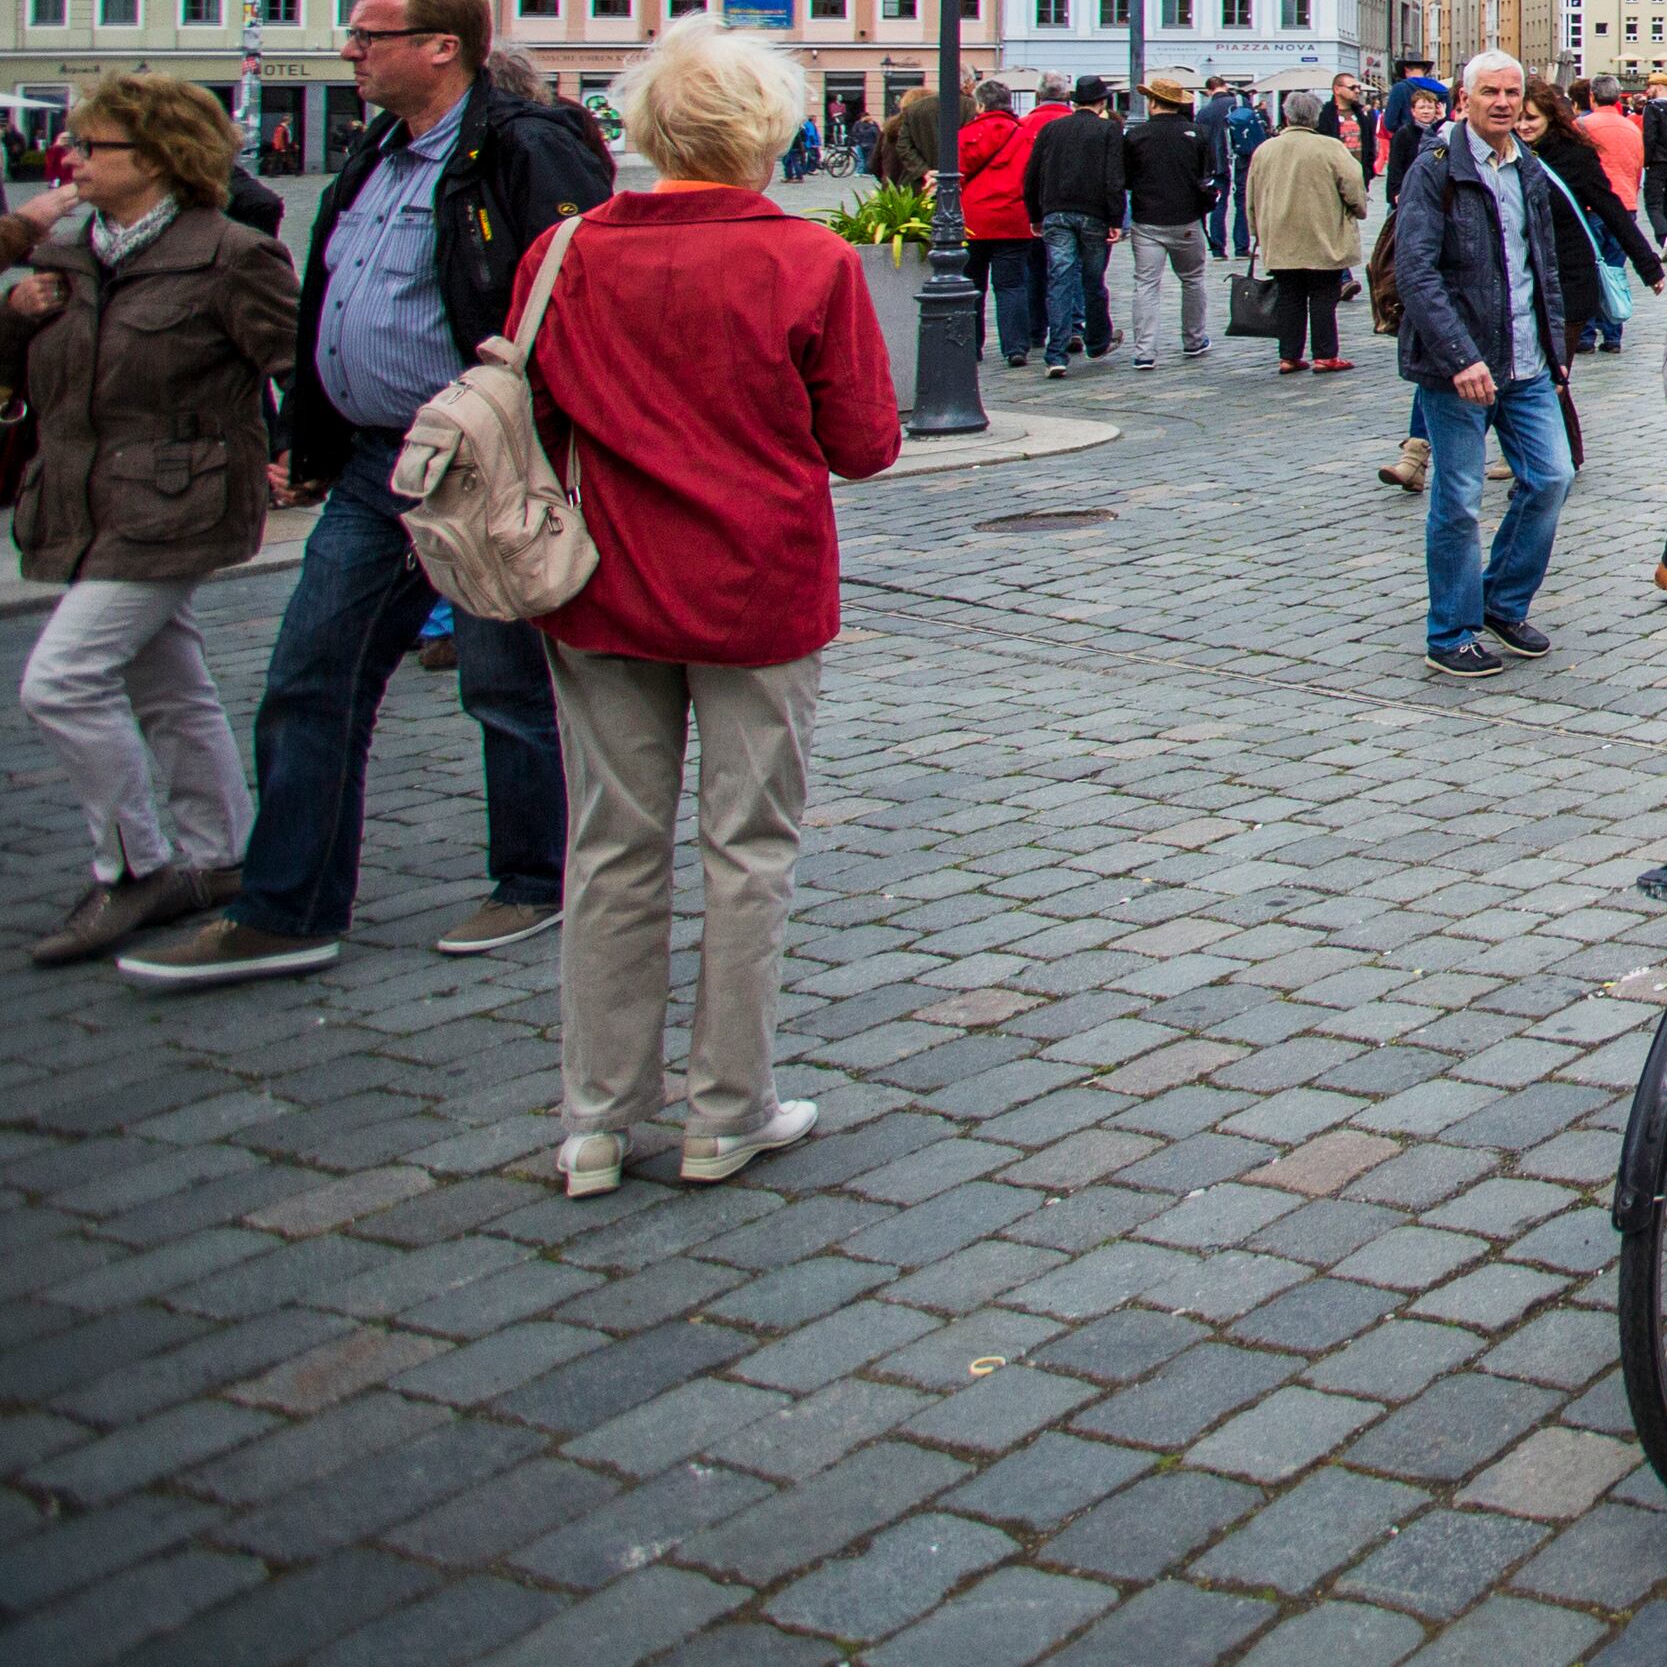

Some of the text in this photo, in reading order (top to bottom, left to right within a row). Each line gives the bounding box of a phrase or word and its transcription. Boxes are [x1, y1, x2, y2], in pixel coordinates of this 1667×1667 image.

[1215, 43, 1316, 52] PIAZZA NOVA
[264, 64, 312, 77] OTEL
